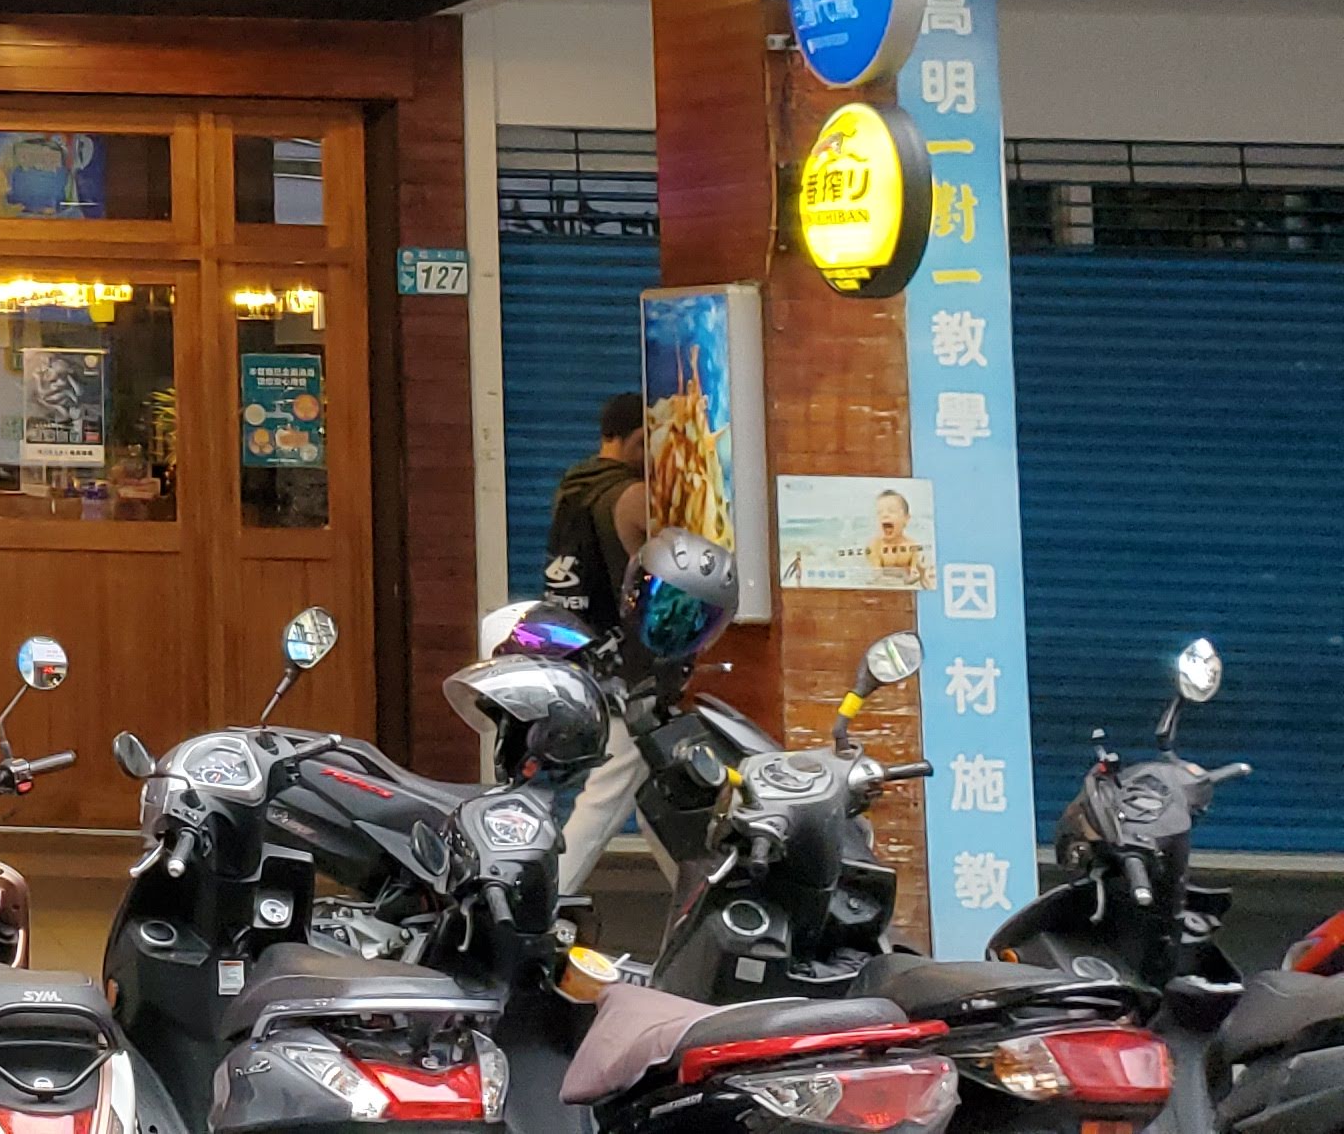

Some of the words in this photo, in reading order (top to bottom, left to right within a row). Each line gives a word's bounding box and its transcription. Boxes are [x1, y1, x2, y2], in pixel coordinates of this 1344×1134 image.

[421, 265, 464, 290] 127
[944, 562, 1012, 912] 因材施教
[23, 990, 63, 1003] SYM
